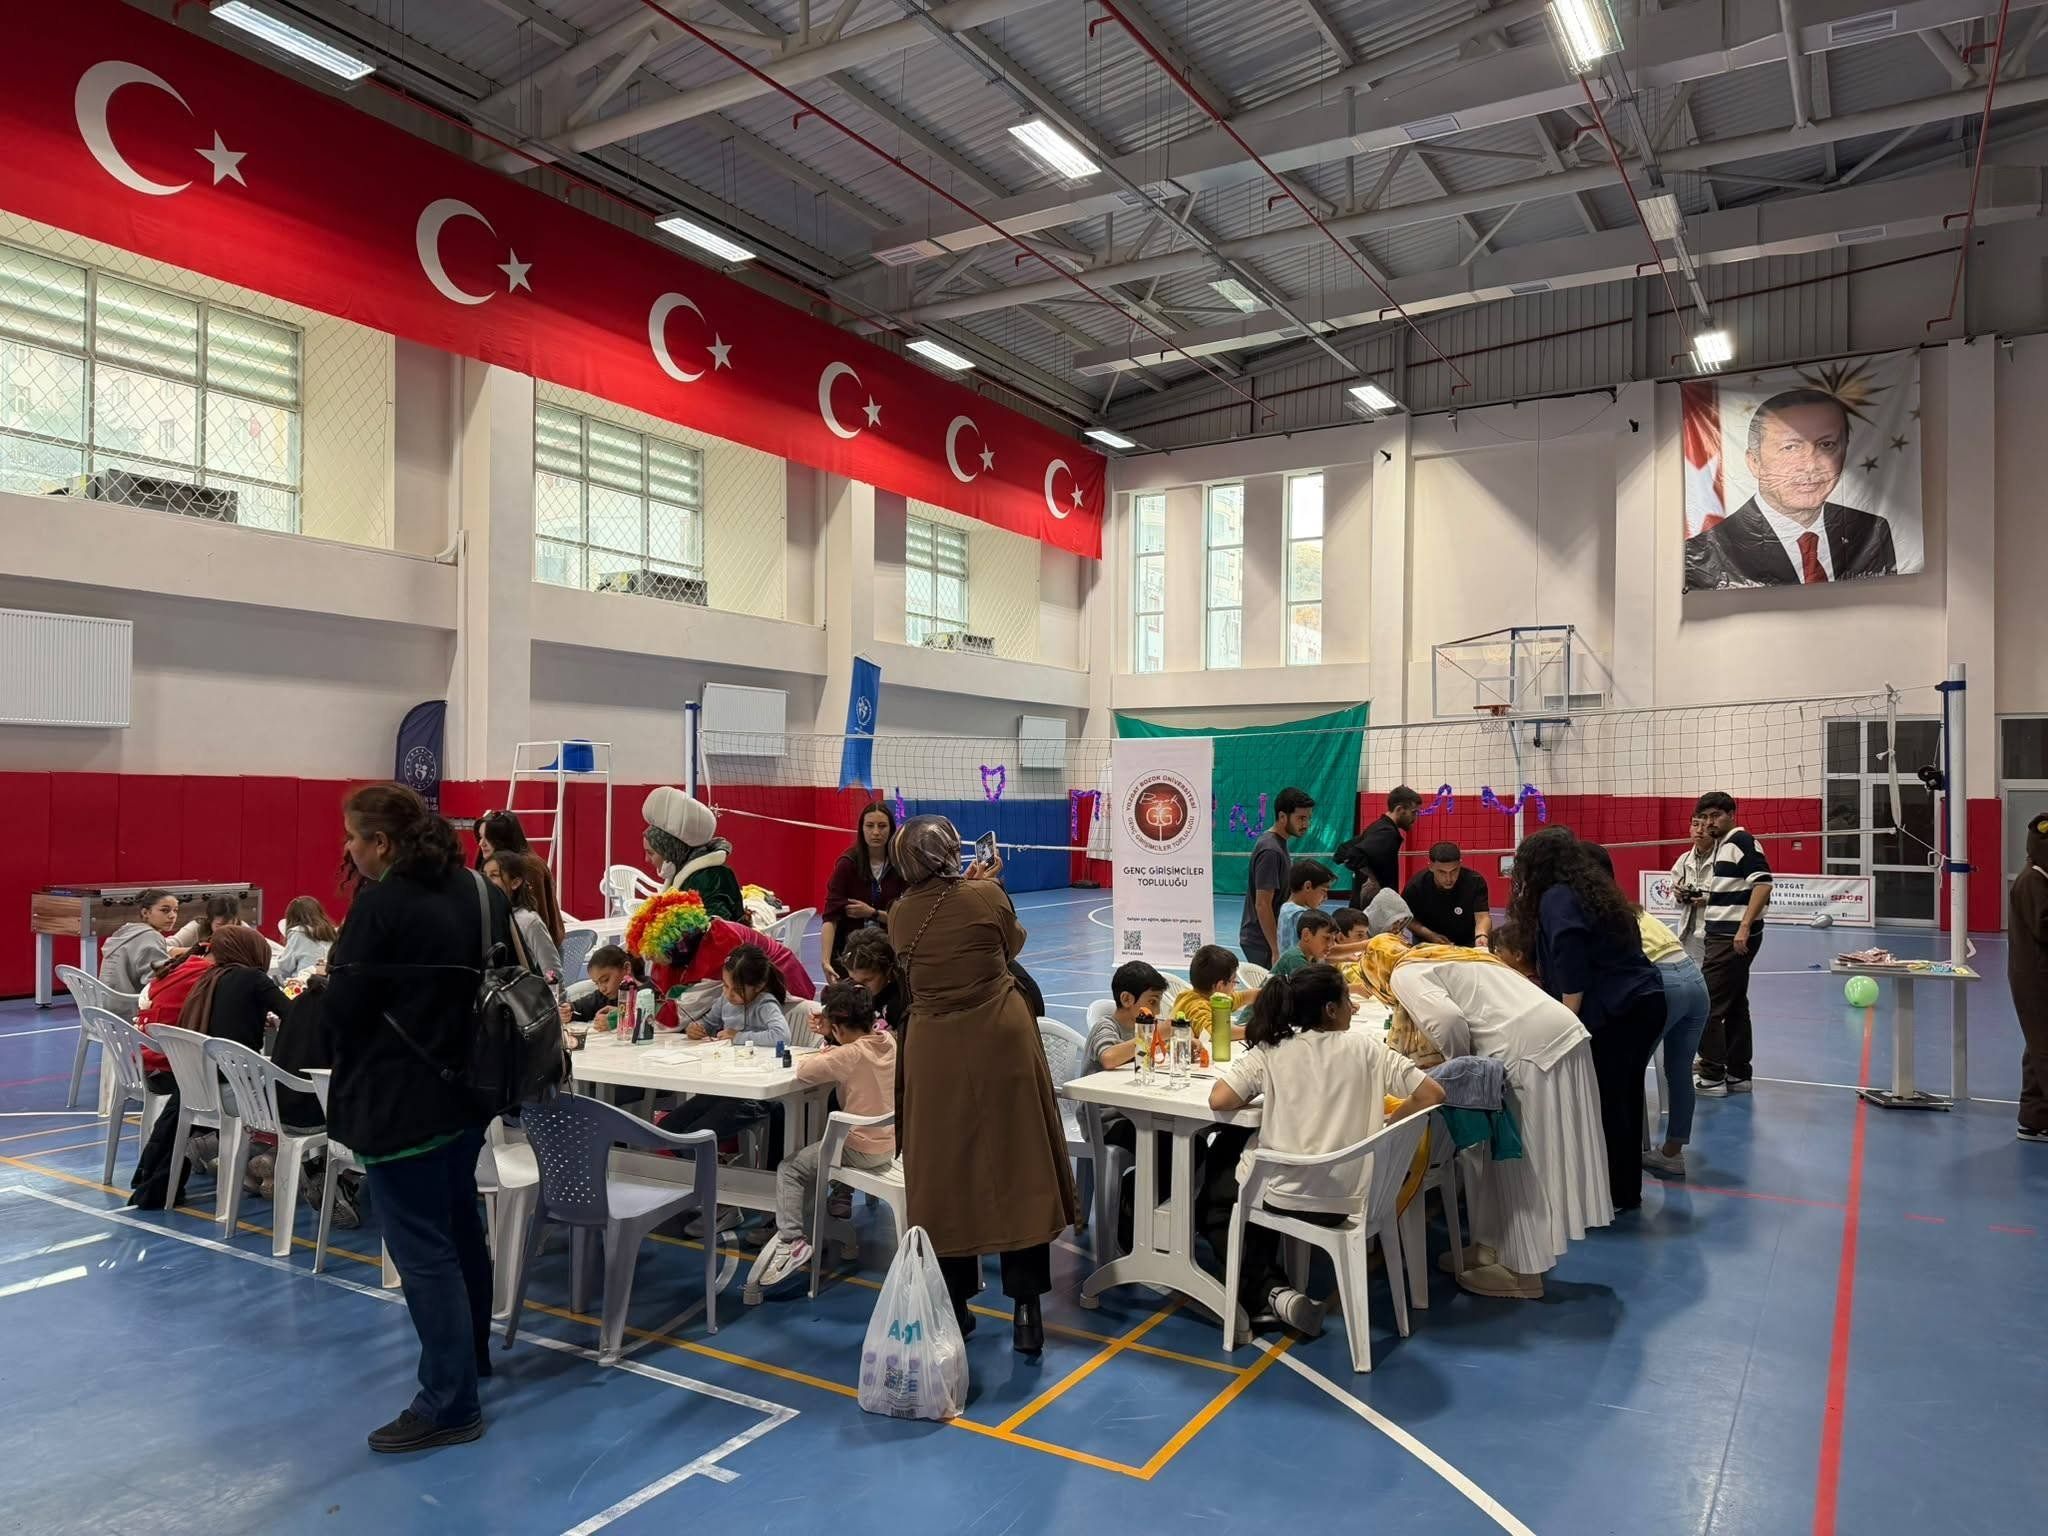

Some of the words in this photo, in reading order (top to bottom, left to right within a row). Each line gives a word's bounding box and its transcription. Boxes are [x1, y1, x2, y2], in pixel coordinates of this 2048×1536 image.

[1126, 786, 1140, 811] YOZGAT
[1140, 775, 1161, 787] BOZOK
[1162, 775, 1197, 809] ÜNİVERSİTESİ
[1172, 815, 1195, 847] TOPLULUĞU
[1123, 866, 1146, 875] GENÇ
[1149, 866, 1204, 876] GİRİŞİMCİLER
[1138, 877, 1188, 887] TOPLULUĞU
